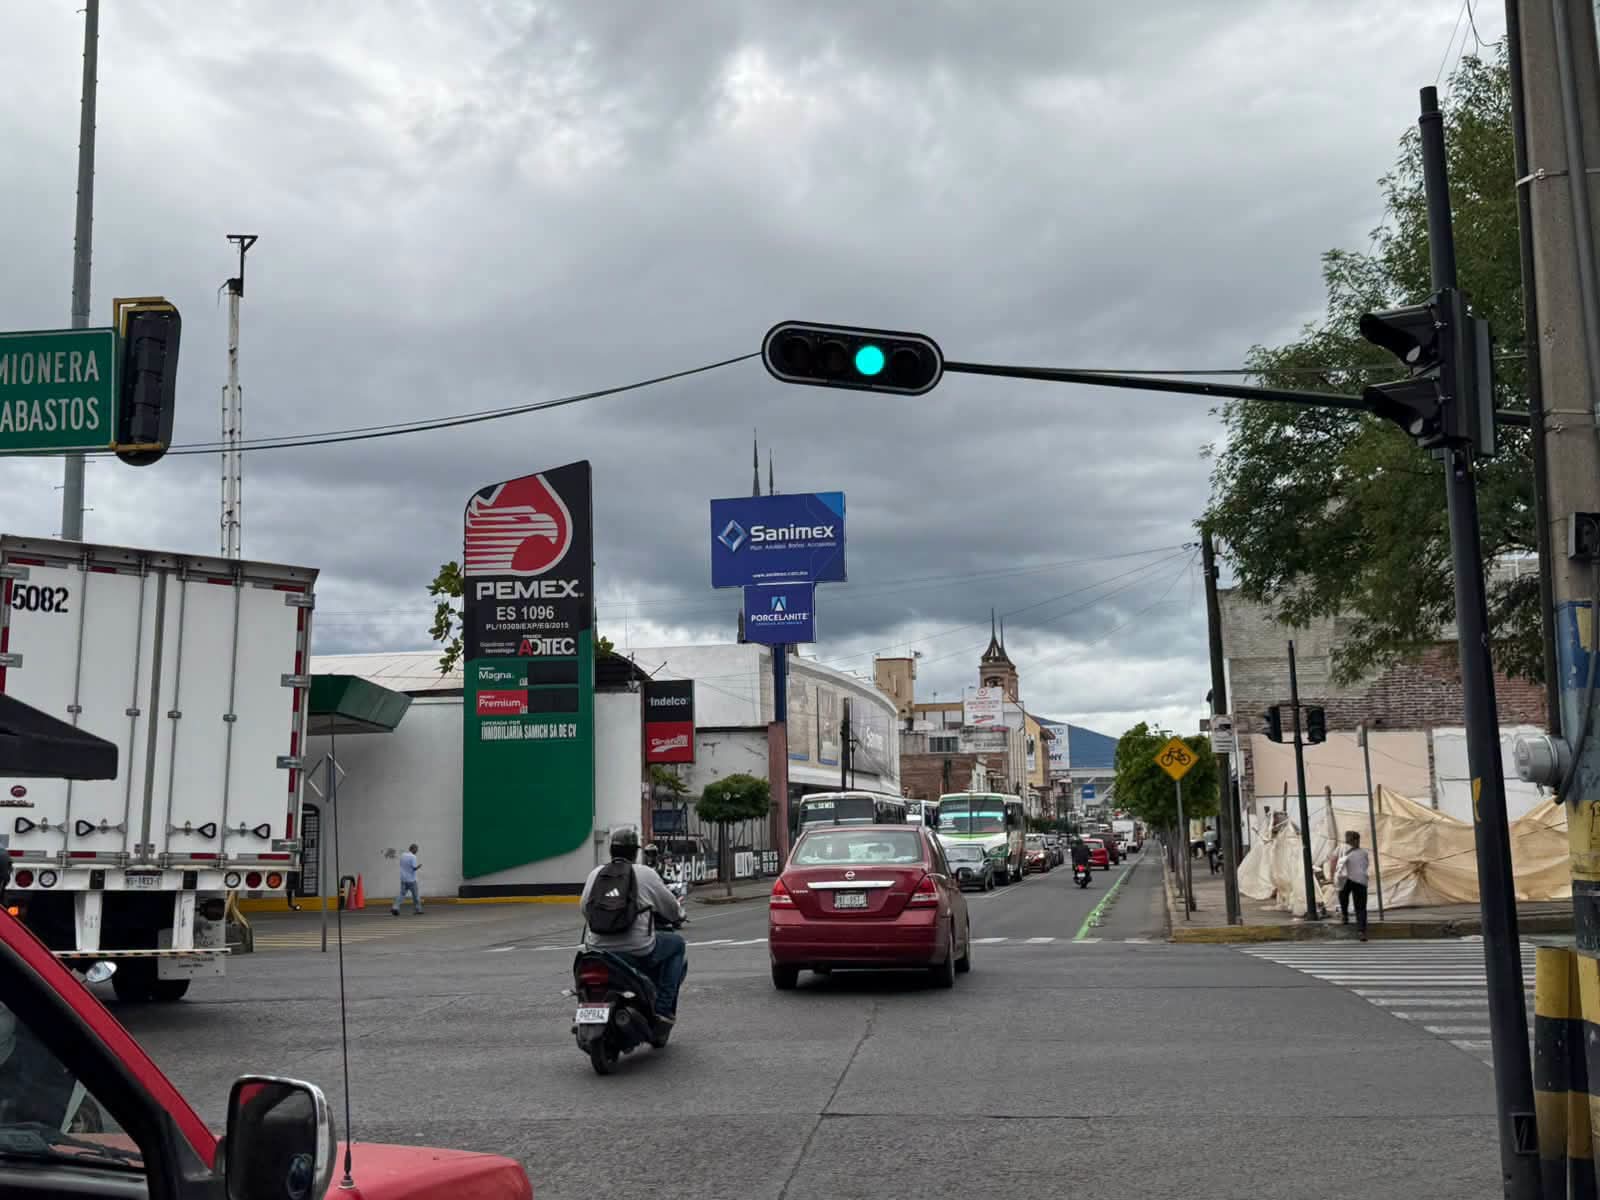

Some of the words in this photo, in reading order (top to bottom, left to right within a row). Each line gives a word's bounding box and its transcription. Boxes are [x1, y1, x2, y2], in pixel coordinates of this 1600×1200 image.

[0, 397, 100, 432] ABASTOS
[750, 523, 834, 542] Sanimex
[12, 584, 69, 613] 5082
[476, 580, 579, 600] PEMEX
[496, 606, 517, 620] ES
[521, 605, 555, 620] 1096
[478, 671, 512, 682] Magna
[479, 698, 521, 708] Premium
[650, 697, 687, 706] Indelco
